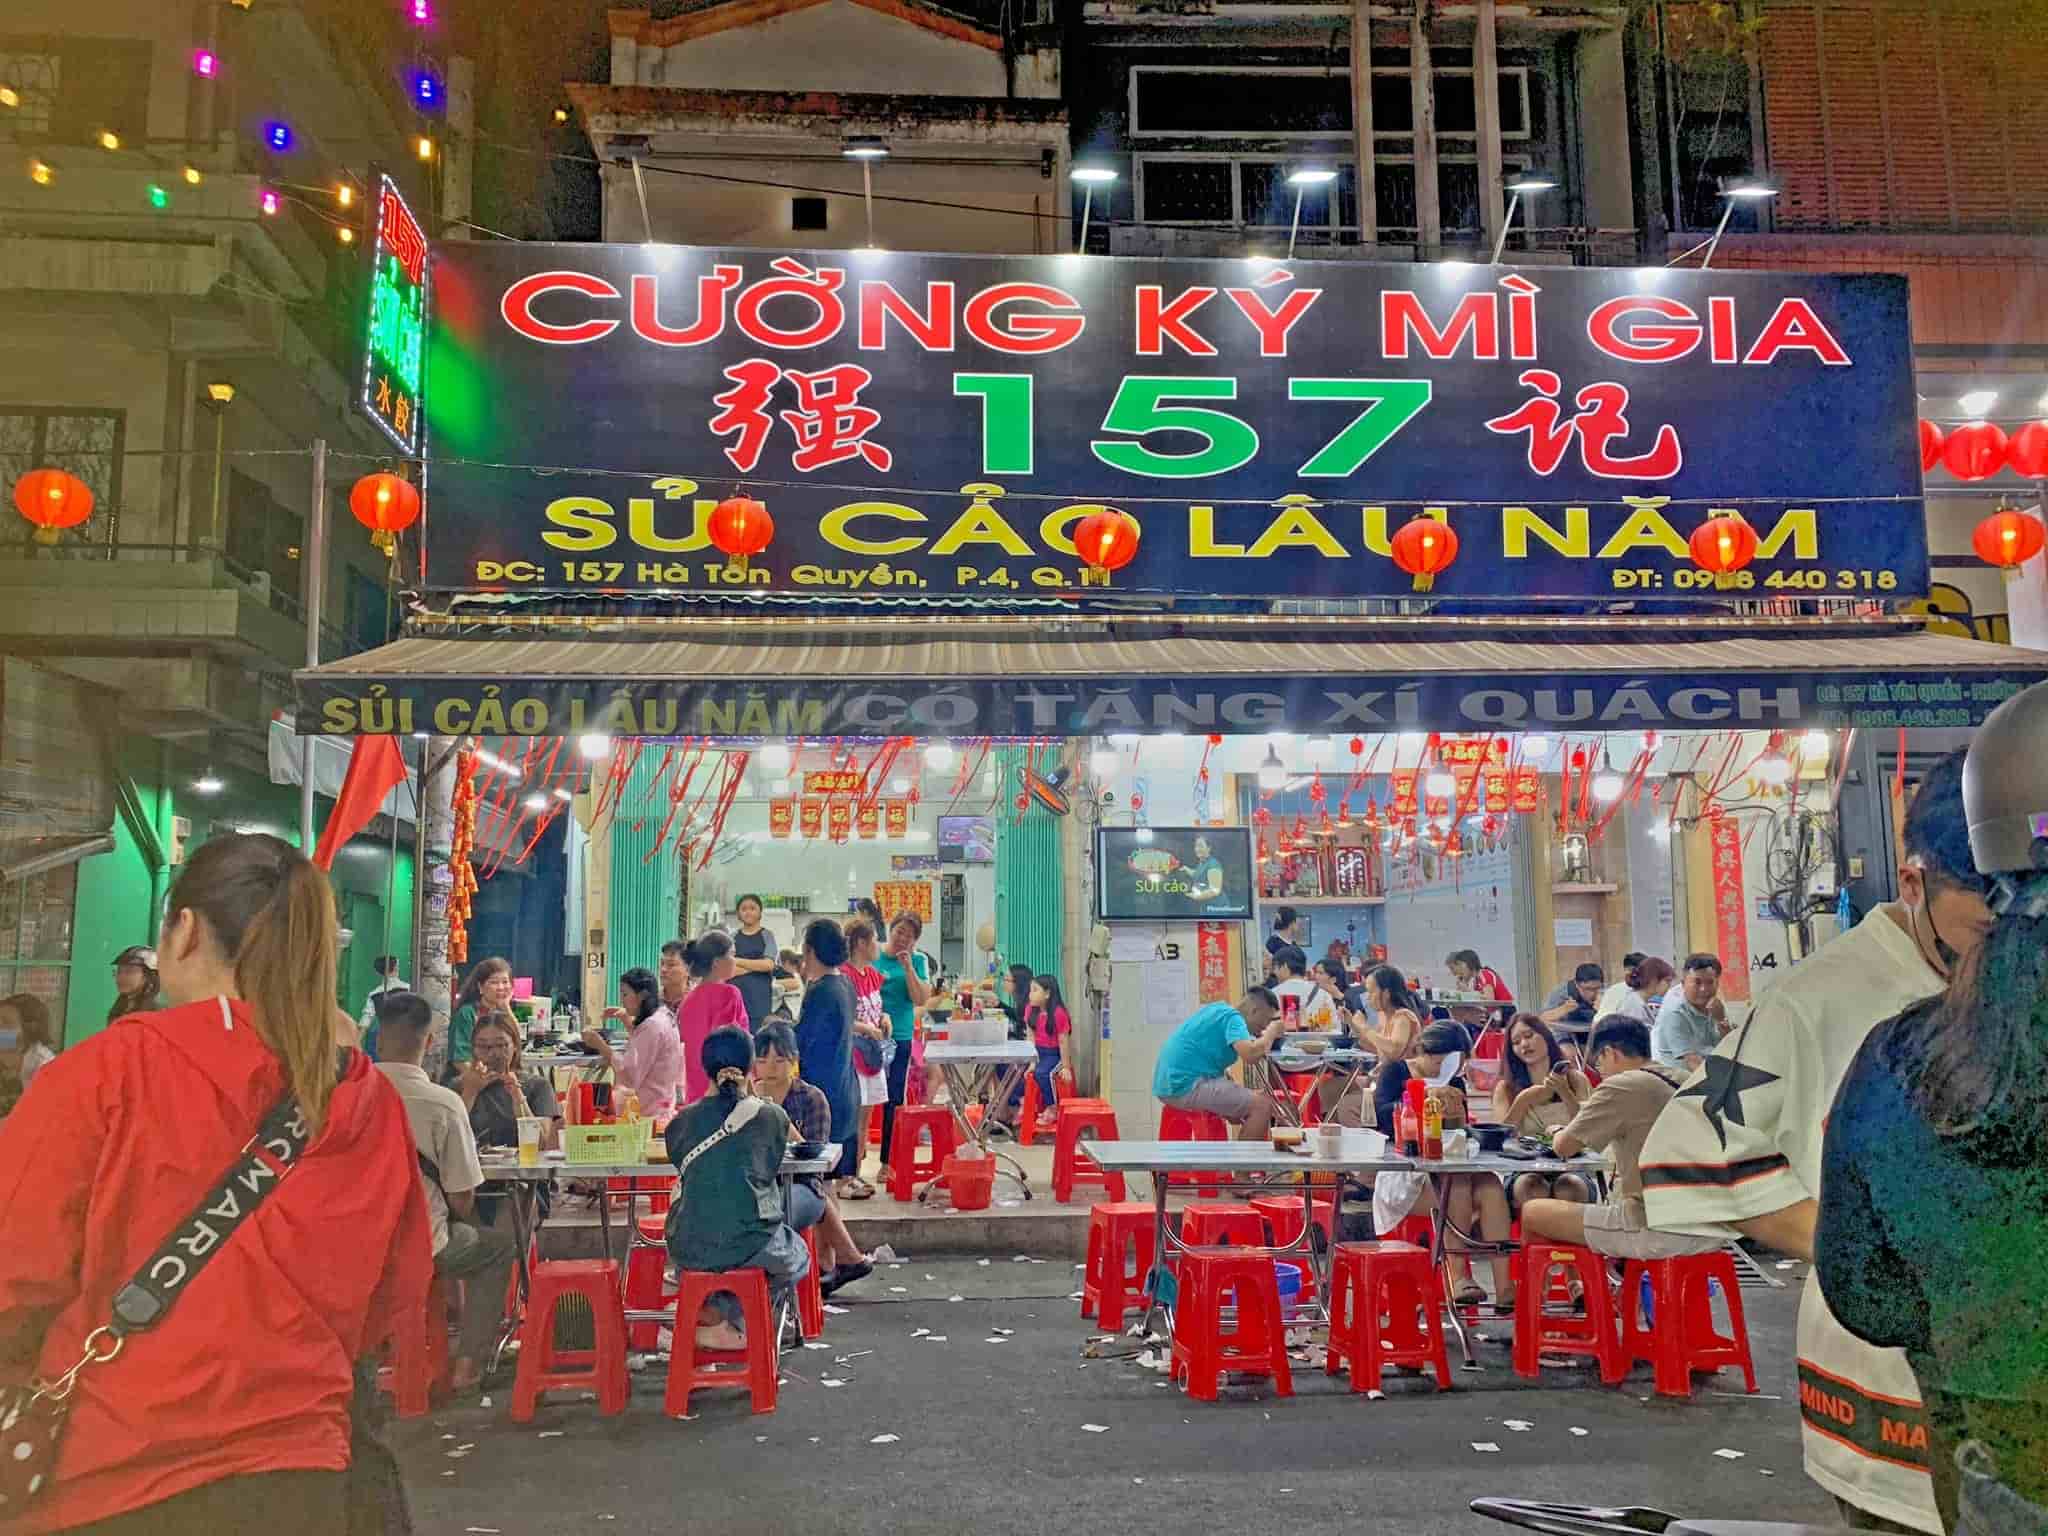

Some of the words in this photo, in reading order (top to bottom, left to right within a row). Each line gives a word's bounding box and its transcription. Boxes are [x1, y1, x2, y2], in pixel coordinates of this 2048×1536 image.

[383, 190, 426, 284] 157
[501, 256, 1086, 354] CƯỜNG
[1134, 267, 1324, 359] KÝ
[1380, 273, 1539, 361] MÌ
[1586, 294, 1854, 367] GIA
[709, 357, 893, 473] 强
[1484, 370, 1684, 480] 记
[952, 371, 1433, 480] 157
[541, 477, 767, 552] SỦ
[476, 561, 545, 581] ĐC:
[562, 562, 625, 582] 157
[637, 561, 689, 583] Hà
[956, 566, 1020, 588] P.4,
[1612, 568, 1663, 588] ĐT:
[1763, 569, 1827, 590] 440
[1836, 570, 1897, 590] 318
[320, 684, 414, 734] SỦI
[433, 683, 549, 734] CẢO
[702, 690, 825, 734] NĂM
[841, 683, 978, 728] CÓ
[1013, 687, 1286, 728] TĂNG
[1322, 683, 1425, 724] XÍ
[1459, 682, 1799, 728] QUÁCH
[1155, 943, 1180, 960] A3
[1751, 952, 1778, 970] A4
[151, 1157, 274, 1288] MARC
[1801, 1382, 1855, 1424] MIND
